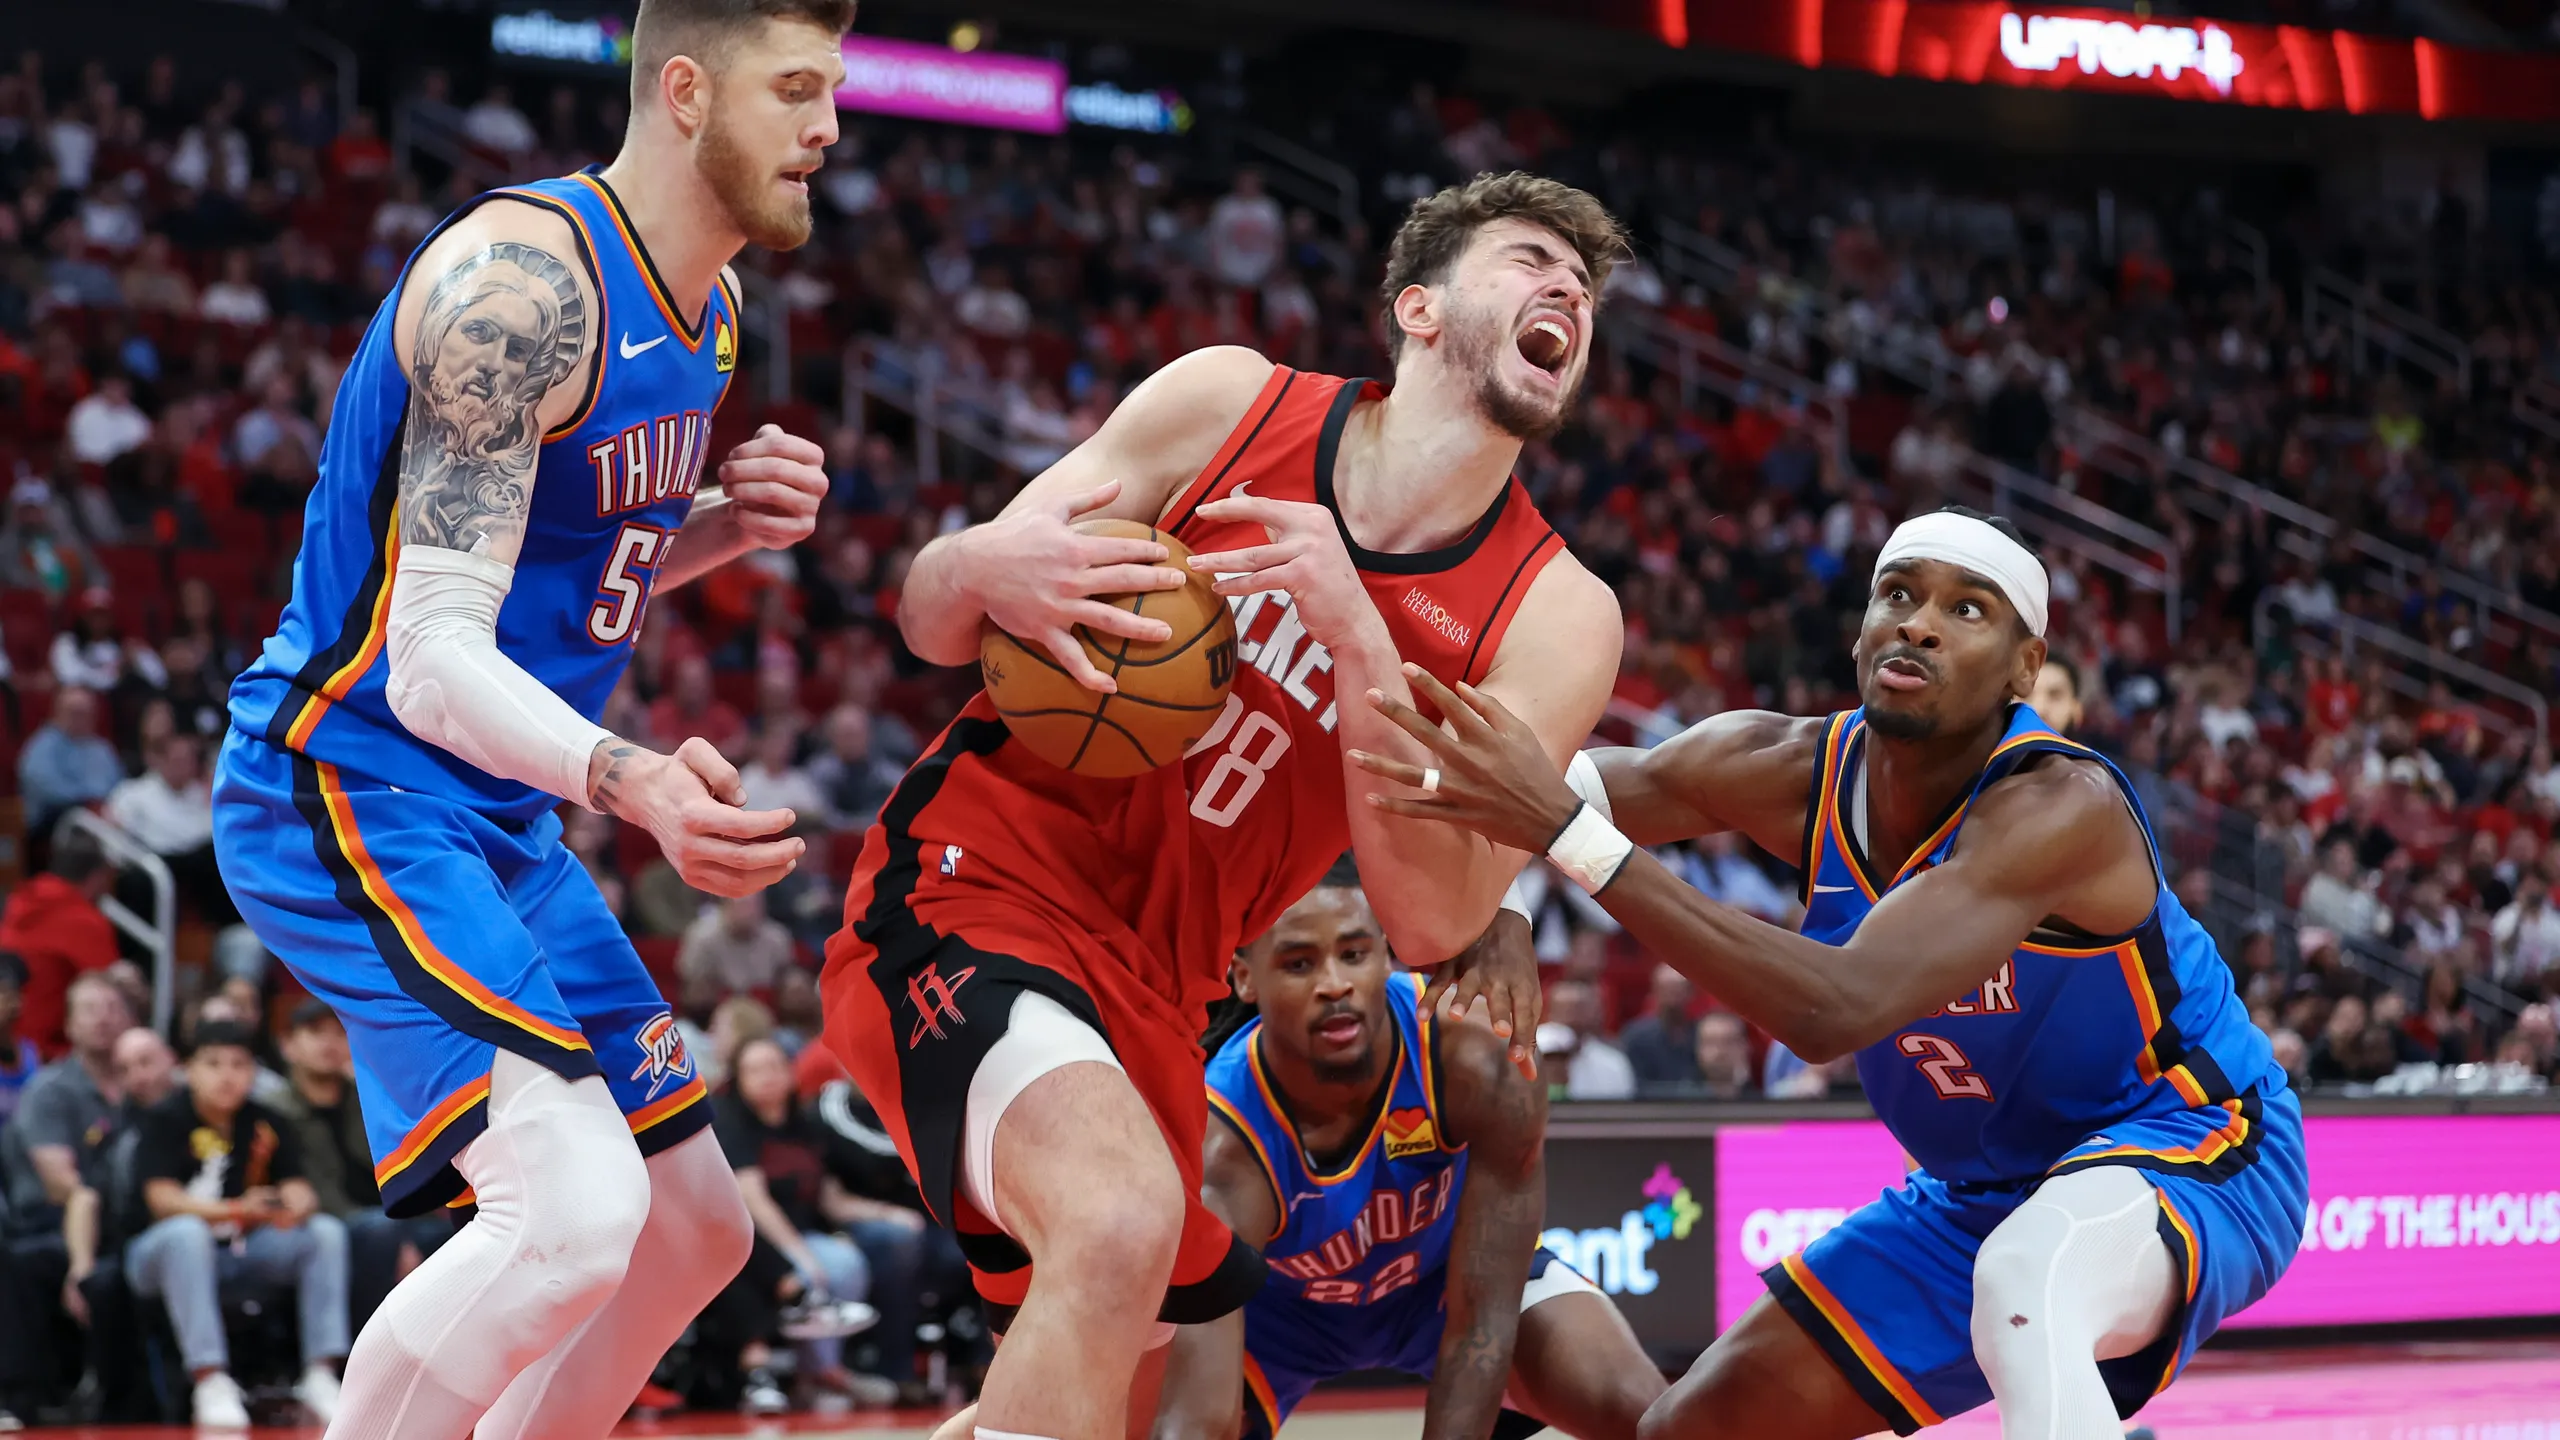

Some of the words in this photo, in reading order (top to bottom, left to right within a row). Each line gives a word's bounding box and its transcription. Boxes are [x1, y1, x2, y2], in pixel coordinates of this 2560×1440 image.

[1402, 597, 1469, 647] HERMANN
[1406, 586, 1470, 638] MEMORIAL
[652, 1024, 680, 1078] OKC
[1897, 1033, 1994, 1102] 2
[2320, 1195, 2376, 1251] OF
[2377, 1194, 2457, 1249] THE
[1541, 1208, 1660, 1295] ant
